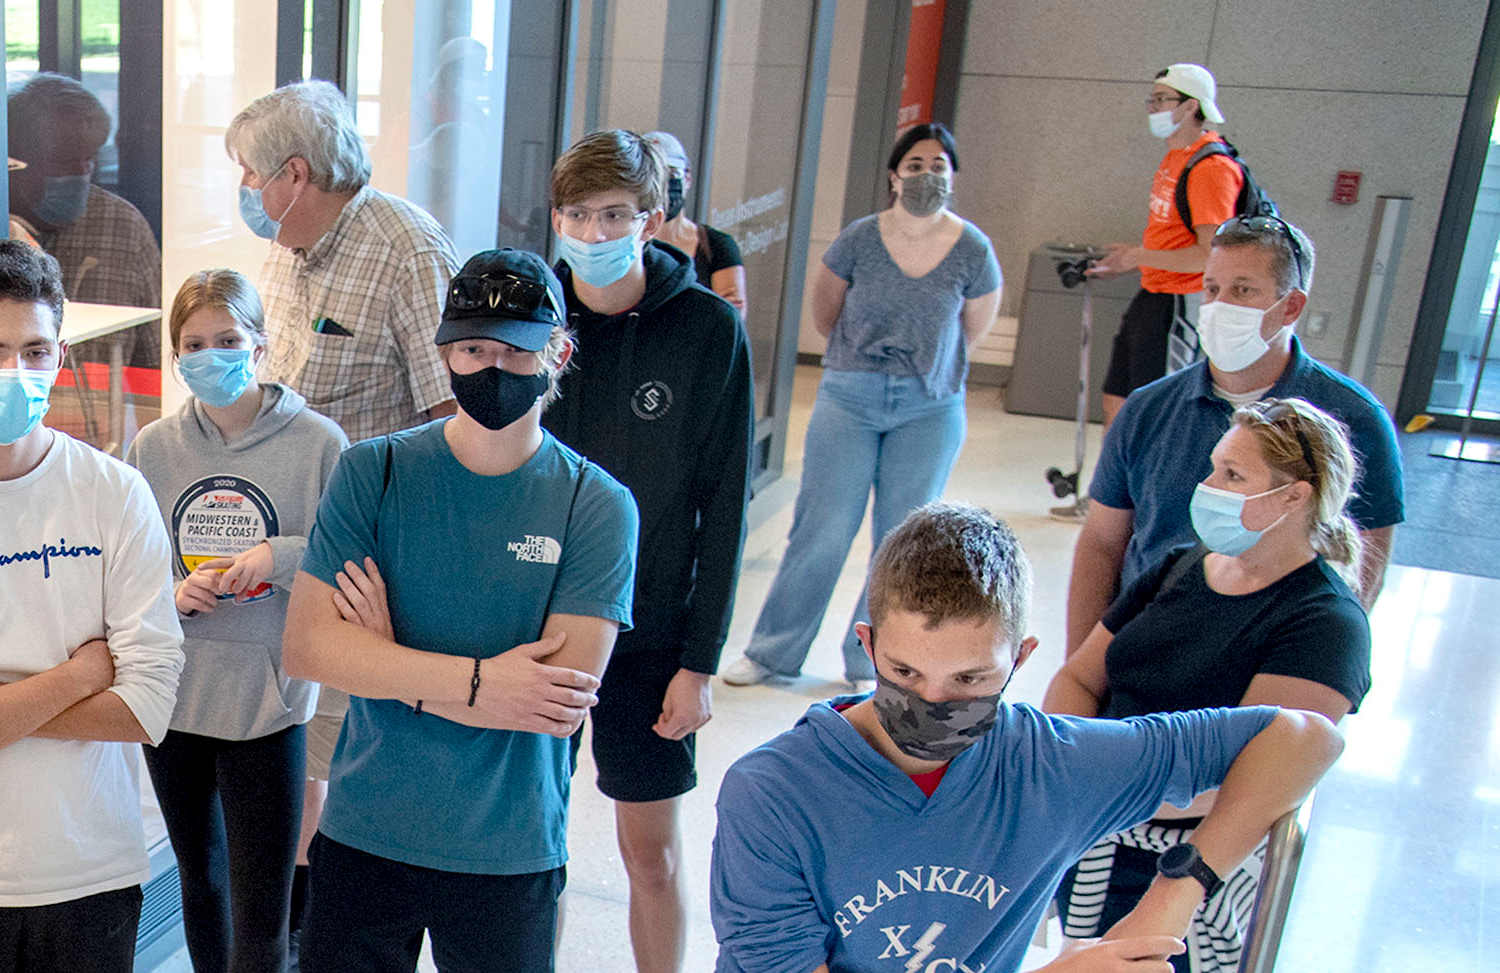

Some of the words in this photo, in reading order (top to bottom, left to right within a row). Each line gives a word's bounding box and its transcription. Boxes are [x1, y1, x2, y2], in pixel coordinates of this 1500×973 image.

[186, 514, 251, 526] MIDWESTERN
[187, 525, 222, 536] PACIFIC
[226, 527, 257, 538] COAST
[182, 537, 232, 546] SYNCHRONIZED
[524, 535, 545, 545] THE
[507, 542, 544, 553] NORTH
[516, 552, 543, 563] FACE
[833, 865, 1010, 938] FRANKLIN
[878, 924, 912, 960] X
